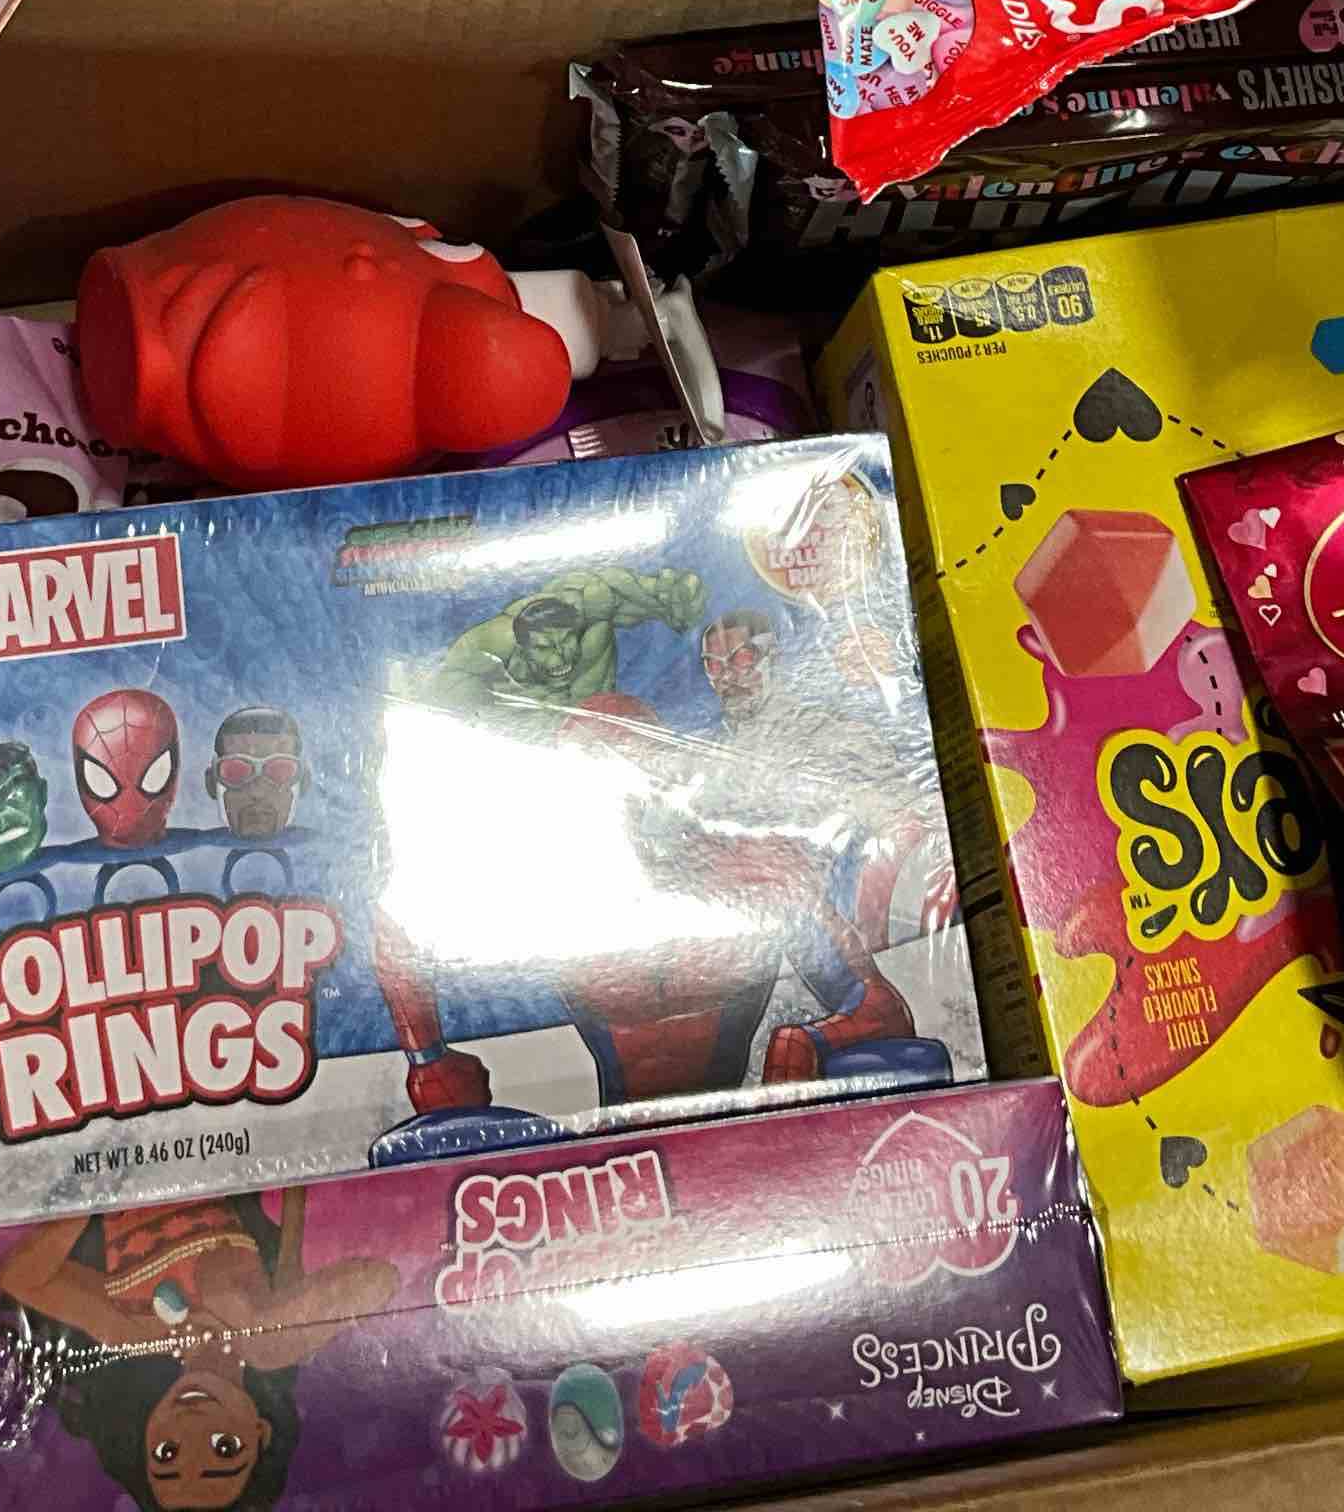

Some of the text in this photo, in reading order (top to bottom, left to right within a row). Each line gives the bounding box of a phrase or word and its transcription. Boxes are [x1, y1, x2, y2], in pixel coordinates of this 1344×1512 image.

[859, 25, 873, 66] MATE
[905, 21, 927, 42] ME
[1042, 78, 1233, 118] valentine's
[1057, 295, 1084, 319] 90
[915, 345, 972, 366] POUCHES
[982, 340, 1007, 357] PER
[1143, 954, 1202, 992] SNACKS
[1143, 985, 1218, 1026] FLAVORED
[1167, 1016, 1210, 1053] FRUIT
[72, 1127, 252, 1175] NET WT 8.46 OZ (240g)
[456, 1151, 671, 1246] RINGS
[949, 1155, 1018, 1229] 20
[851, 1302, 1062, 1388] PRINCESS
